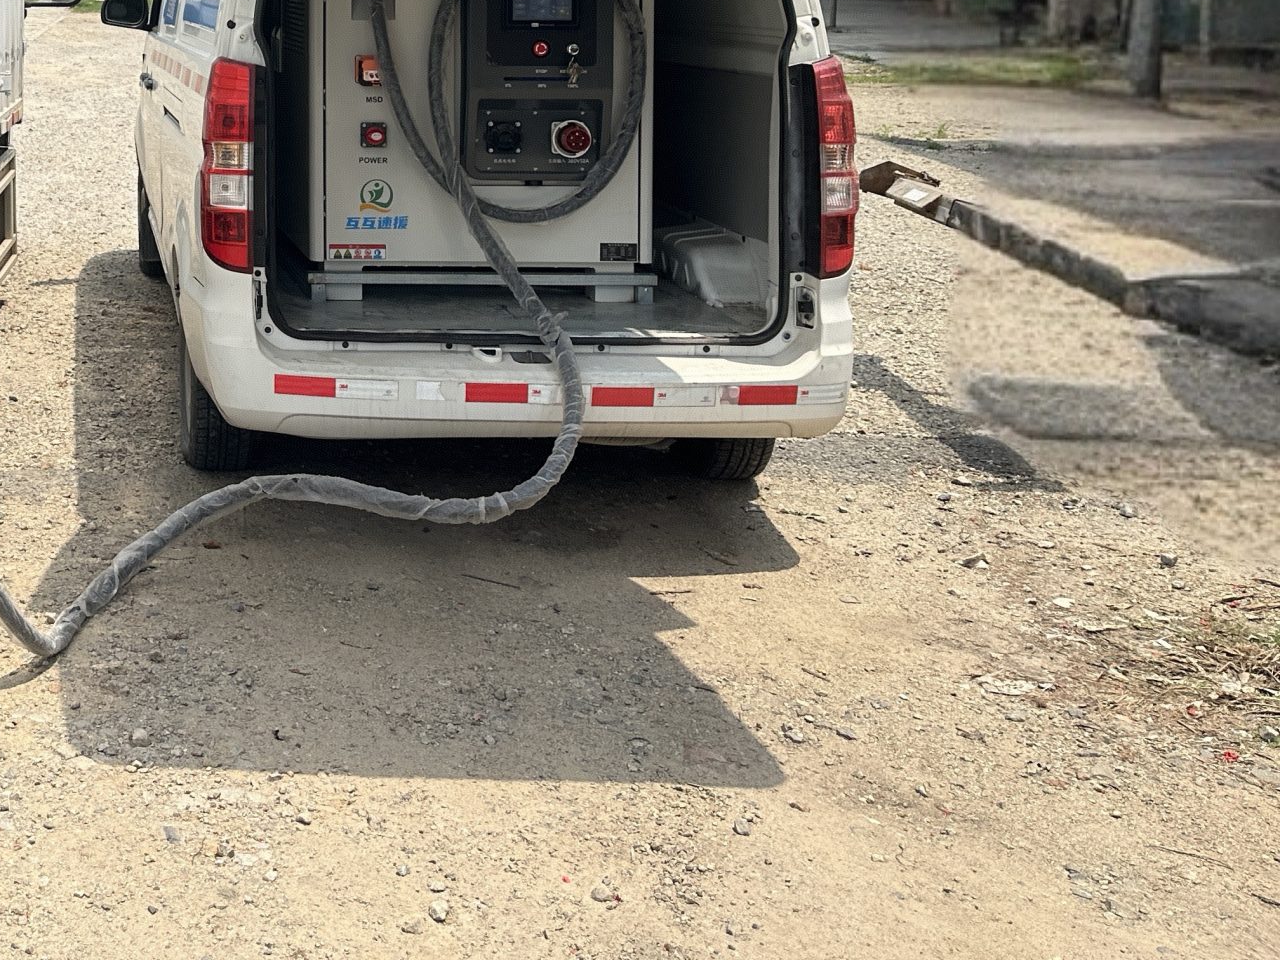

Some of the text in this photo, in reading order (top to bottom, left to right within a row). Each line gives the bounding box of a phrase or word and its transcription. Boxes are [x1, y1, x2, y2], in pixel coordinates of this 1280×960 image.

[358, 156, 388, 164] POWER
[345, 215, 409, 230] 互互速援
